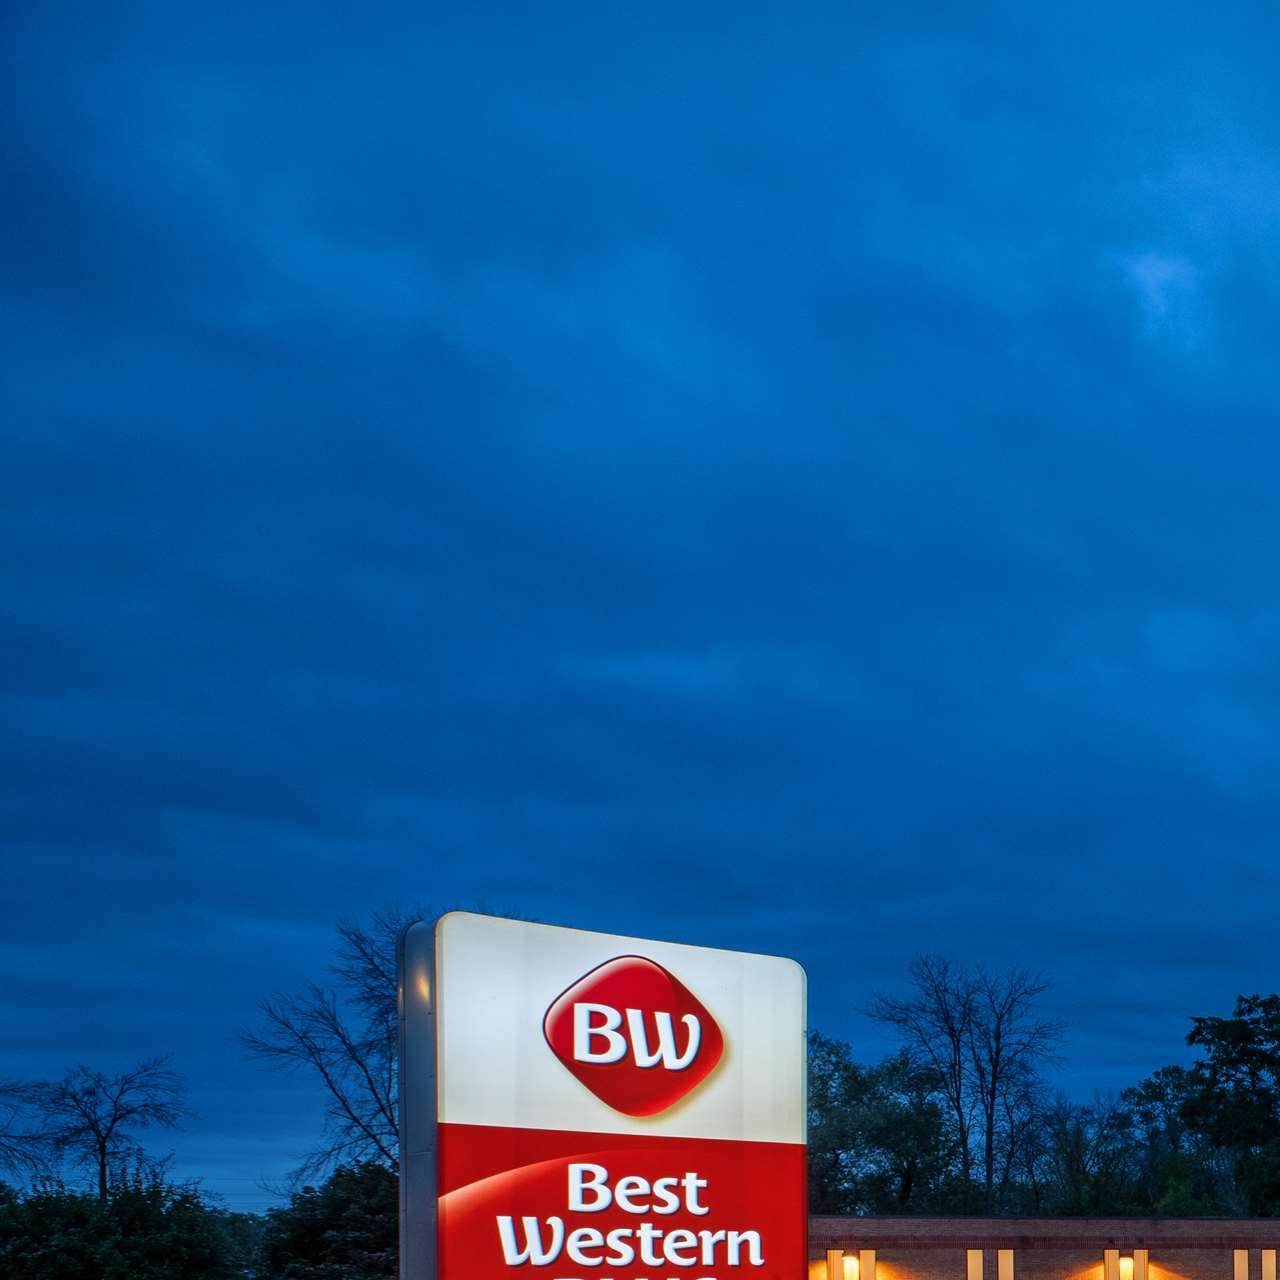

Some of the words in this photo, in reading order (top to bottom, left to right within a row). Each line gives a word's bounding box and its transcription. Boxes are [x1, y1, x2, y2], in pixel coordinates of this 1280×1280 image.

[572, 1003, 701, 1070] BW
[568, 1163, 709, 1215] Best
[496, 1216, 765, 1266] Western
